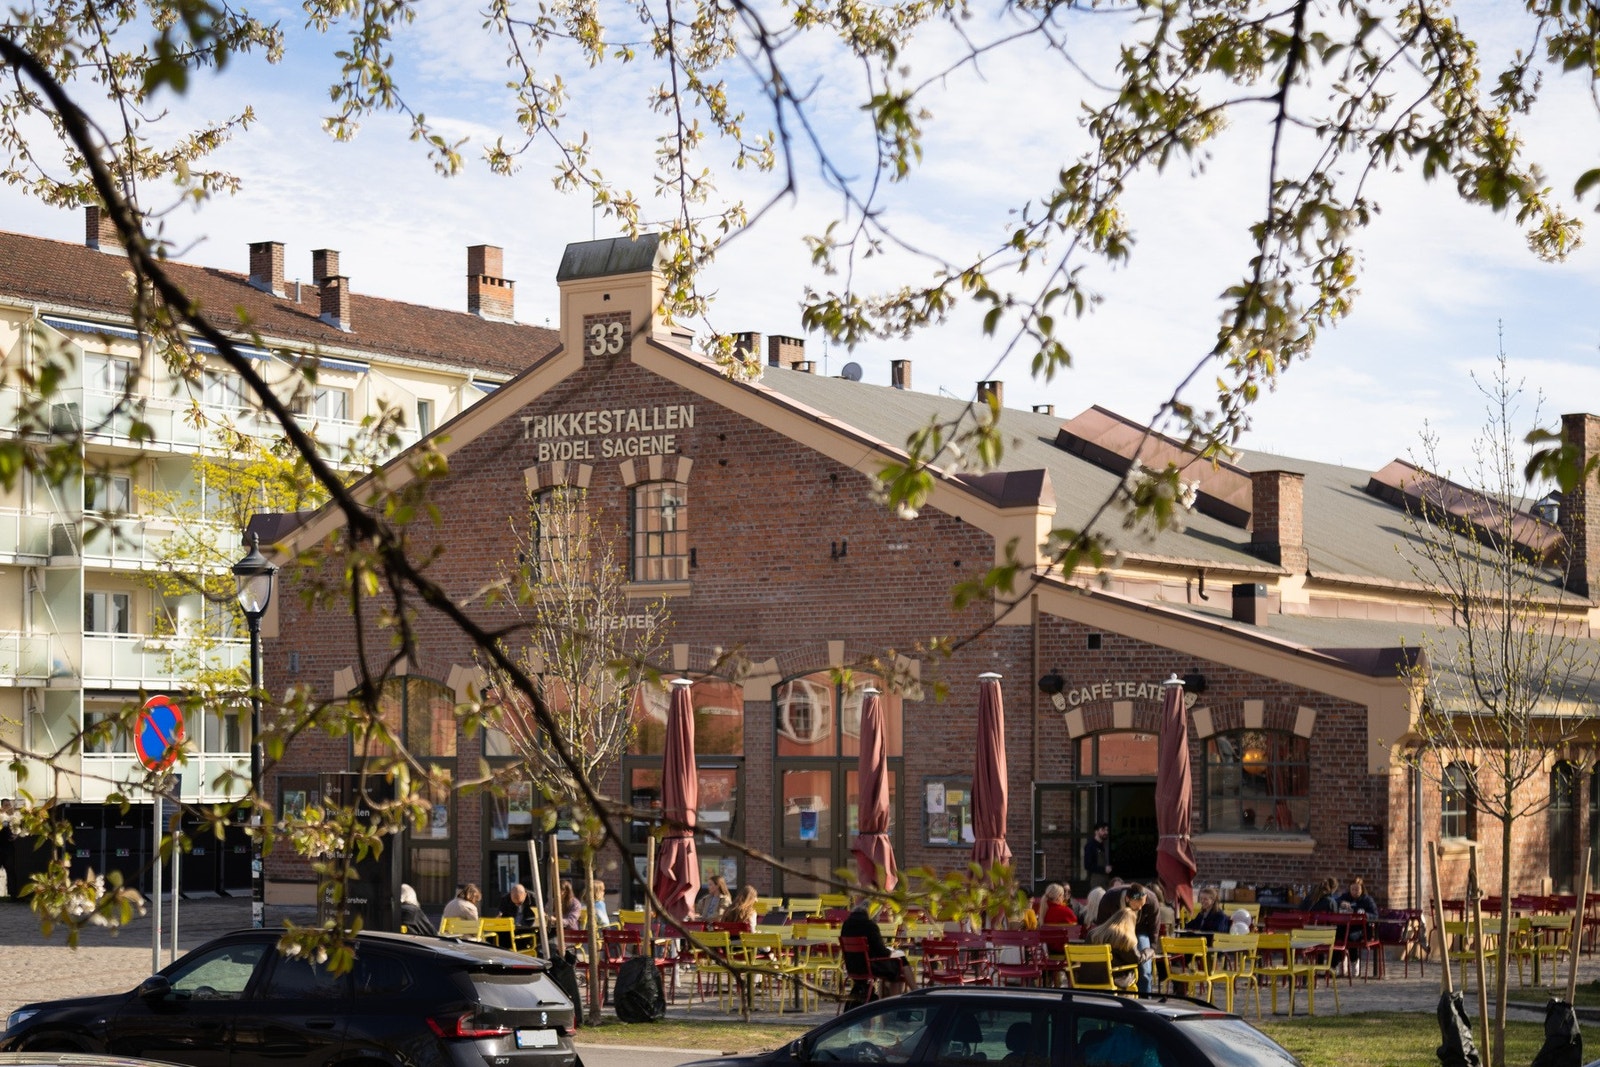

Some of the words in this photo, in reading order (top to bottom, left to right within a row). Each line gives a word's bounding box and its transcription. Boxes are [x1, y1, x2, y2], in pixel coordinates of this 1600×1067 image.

[590, 322, 624, 356] 33
[520, 404, 695, 439] TRIKKESTALLEN
[538, 440, 595, 462] BYDEL
[601, 435, 676, 458] SAGENE
[1068, 679, 1113, 706] CAFÉ
[1114, 682, 1166, 702] TEATE
